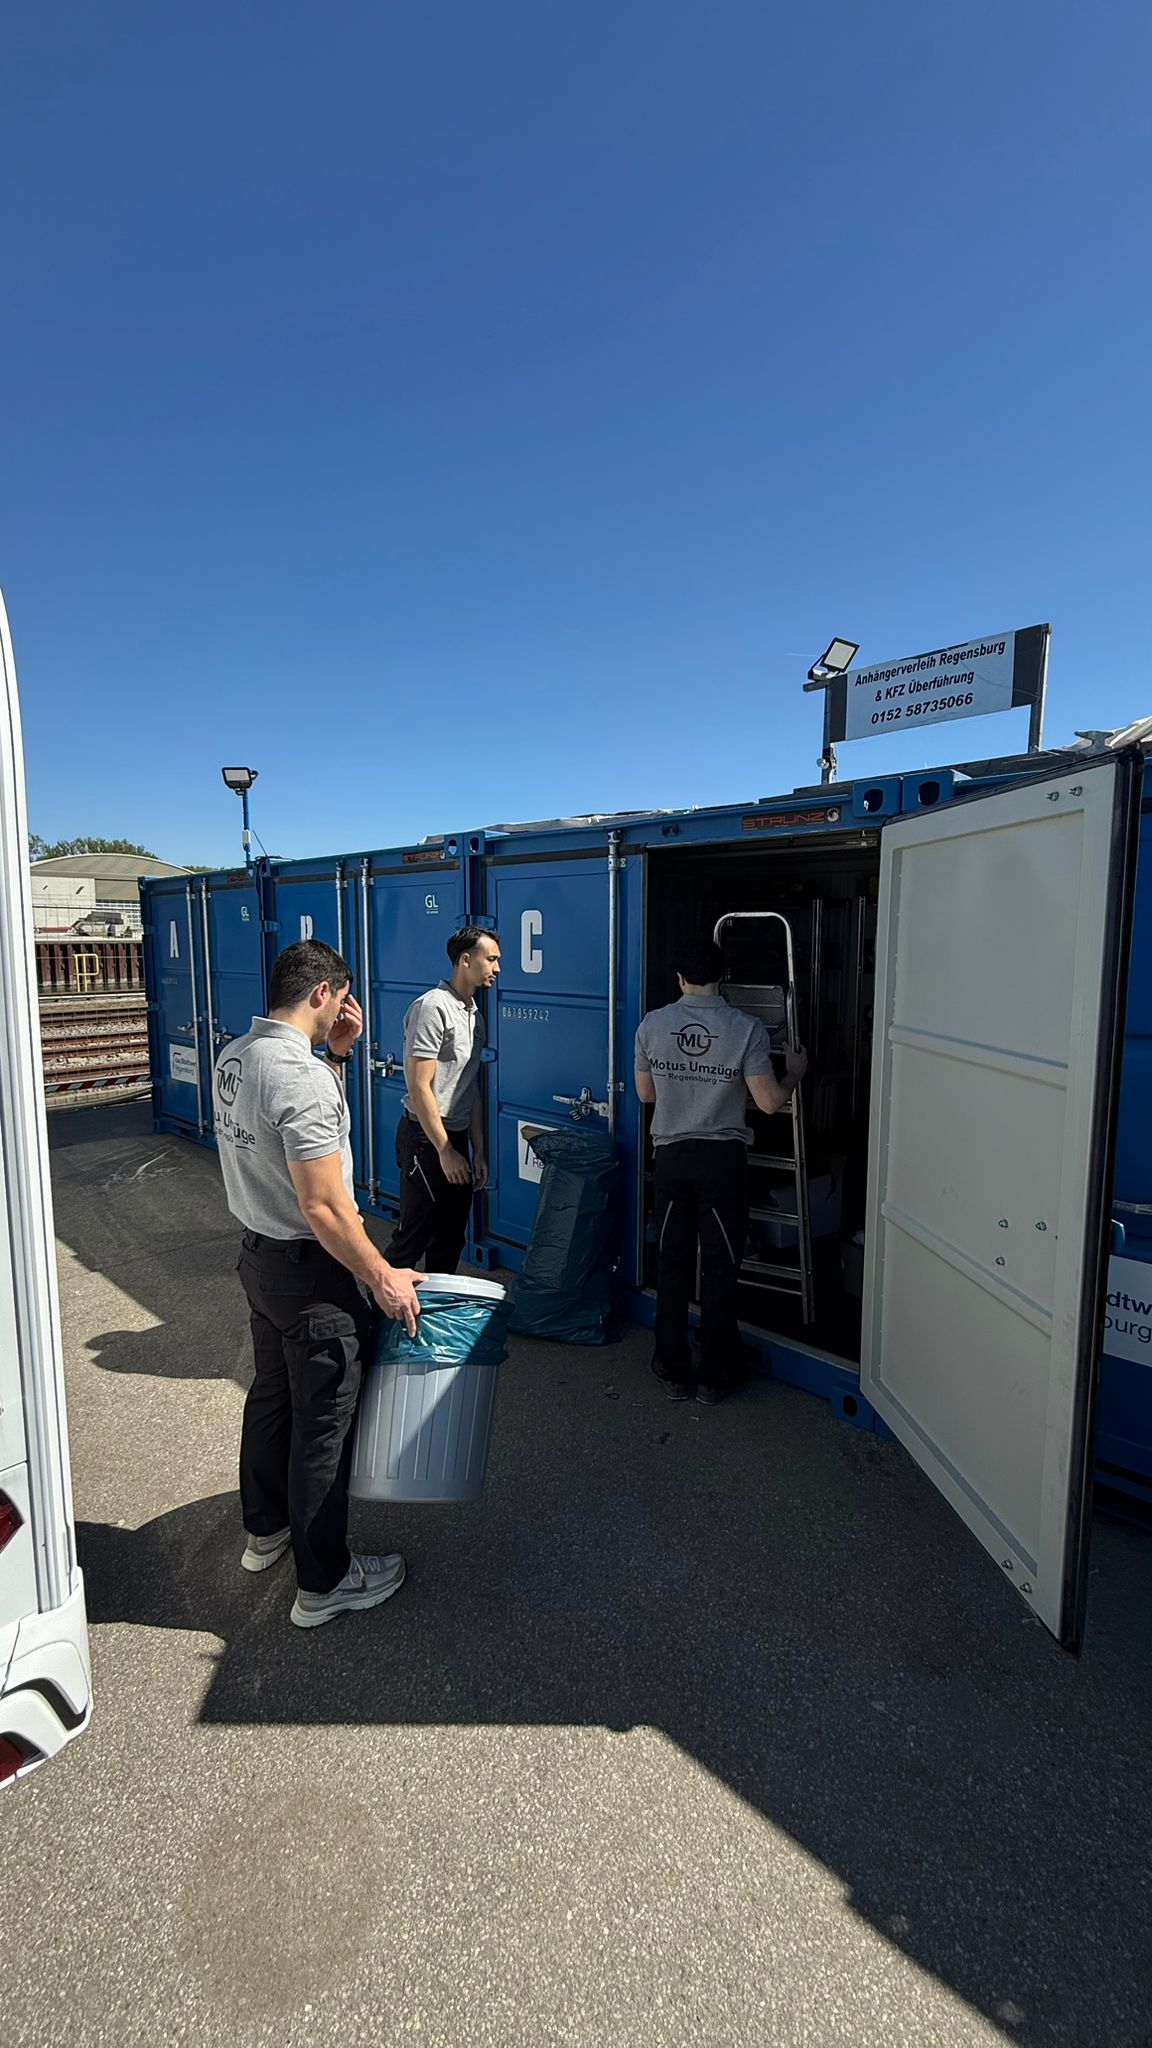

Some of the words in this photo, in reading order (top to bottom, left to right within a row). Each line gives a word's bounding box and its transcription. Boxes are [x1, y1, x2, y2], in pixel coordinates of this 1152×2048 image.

[855, 658, 936, 687] Anhängerverleih
[939, 641, 1005, 666] Regensburg
[875, 690, 882, 702] &
[885, 684, 905, 700] KFZ
[908, 671, 975, 695] Überführung
[871, 707, 901, 724] 0152
[905, 692, 973, 717] 58735066
[425, 894, 439, 908] GL
[170, 920, 179, 958] A
[521, 909, 542, 973] C
[650, 1058, 686, 1071] Motus
[689, 1061, 740, 1079] Umzüge
[668, 1073, 717, 1085] Regensburg
